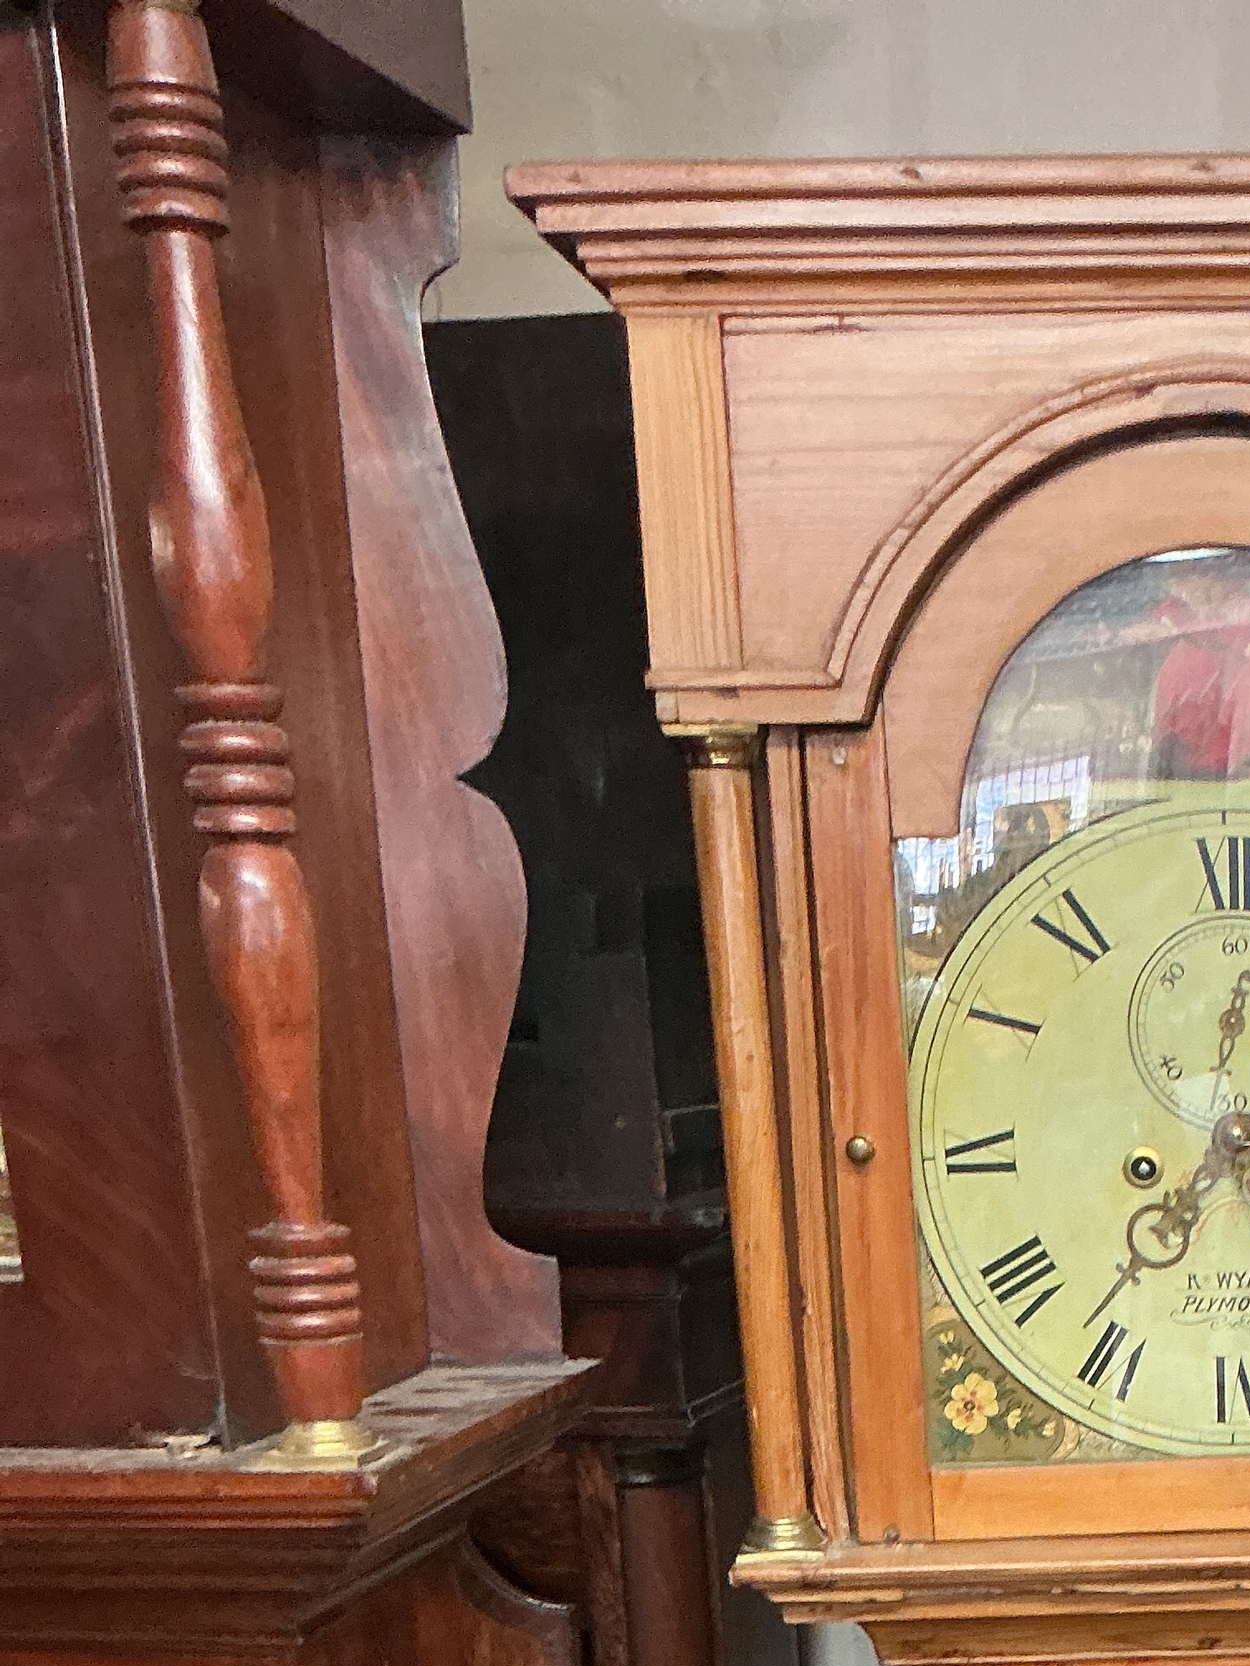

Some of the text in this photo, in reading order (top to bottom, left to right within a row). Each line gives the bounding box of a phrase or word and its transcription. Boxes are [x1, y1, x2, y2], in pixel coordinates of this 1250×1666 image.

[1028, 886, 1115, 981] XI
[1221, 935, 1248, 956] 60
[1160, 961, 1185, 993] 50
[962, 983, 1047, 1060] X
[1159, 1055, 1183, 1081] 40
[944, 1122, 1019, 1182] IX
[977, 1231, 1066, 1330] VIII
[1076, 1320, 1147, 1402] VII
